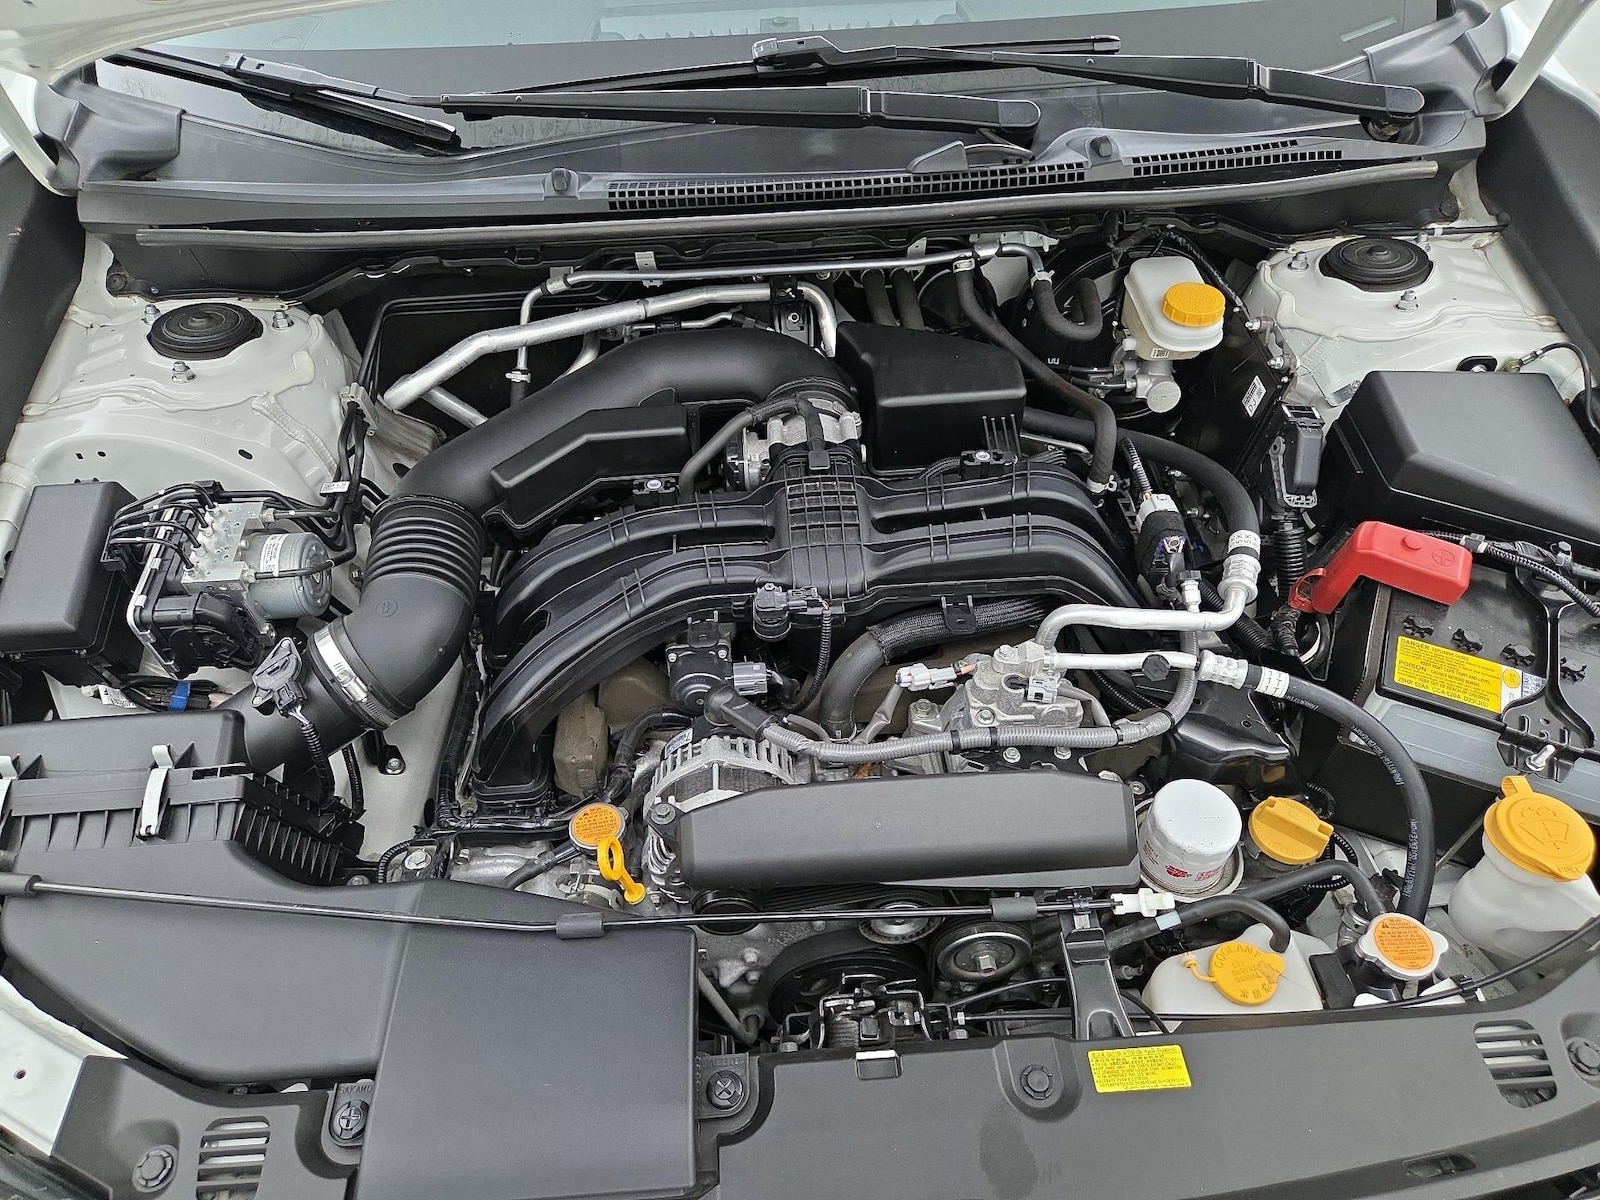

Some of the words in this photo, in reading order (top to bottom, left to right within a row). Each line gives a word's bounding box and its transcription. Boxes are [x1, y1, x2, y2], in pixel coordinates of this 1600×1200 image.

[1400, 638, 1429, 650] DANGER
[1398, 659, 1426, 672] POISON
[1432, 687, 1446, 695] CCA
[1214, 943, 1261, 968] COOLANT
